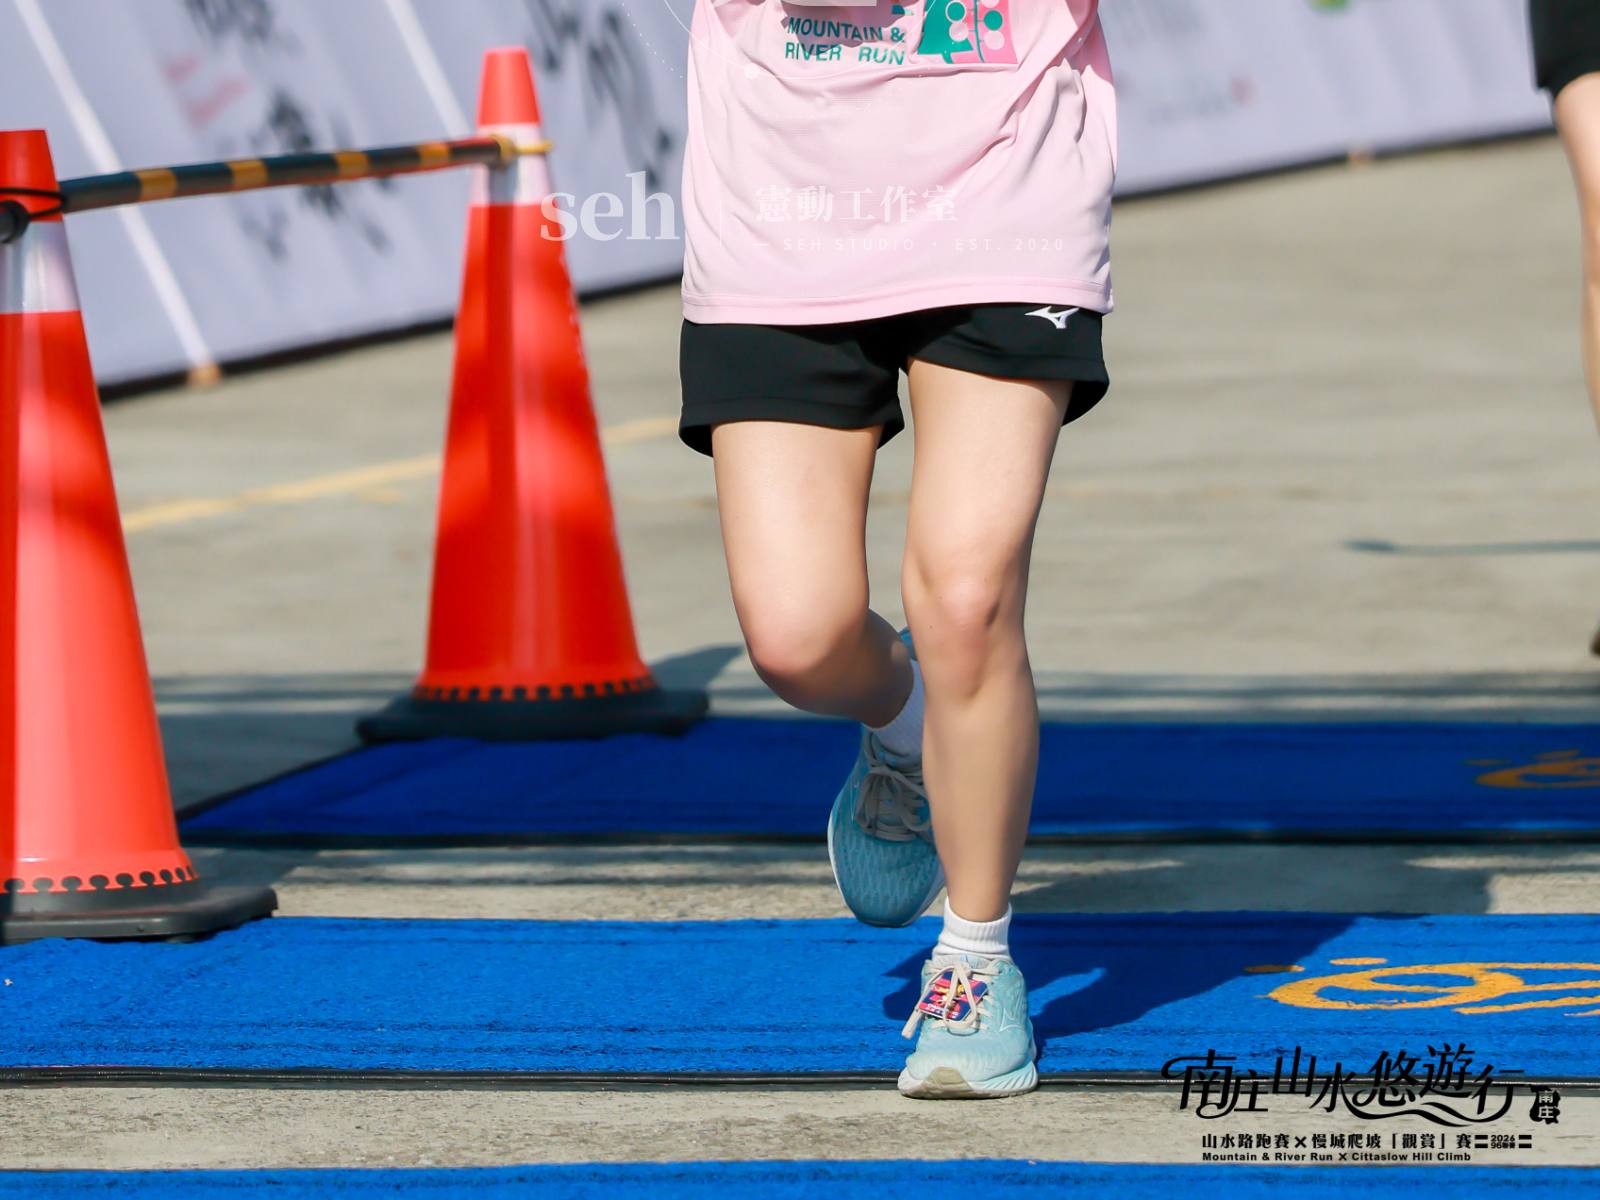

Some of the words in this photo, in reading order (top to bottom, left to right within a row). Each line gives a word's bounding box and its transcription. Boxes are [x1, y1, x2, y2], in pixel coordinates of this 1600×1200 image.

[787, 17, 883, 40] MOUNTAIN
[889, 27, 905, 43] &
[785, 42, 842, 62] RIVER
[858, 46, 905, 65] RUN
